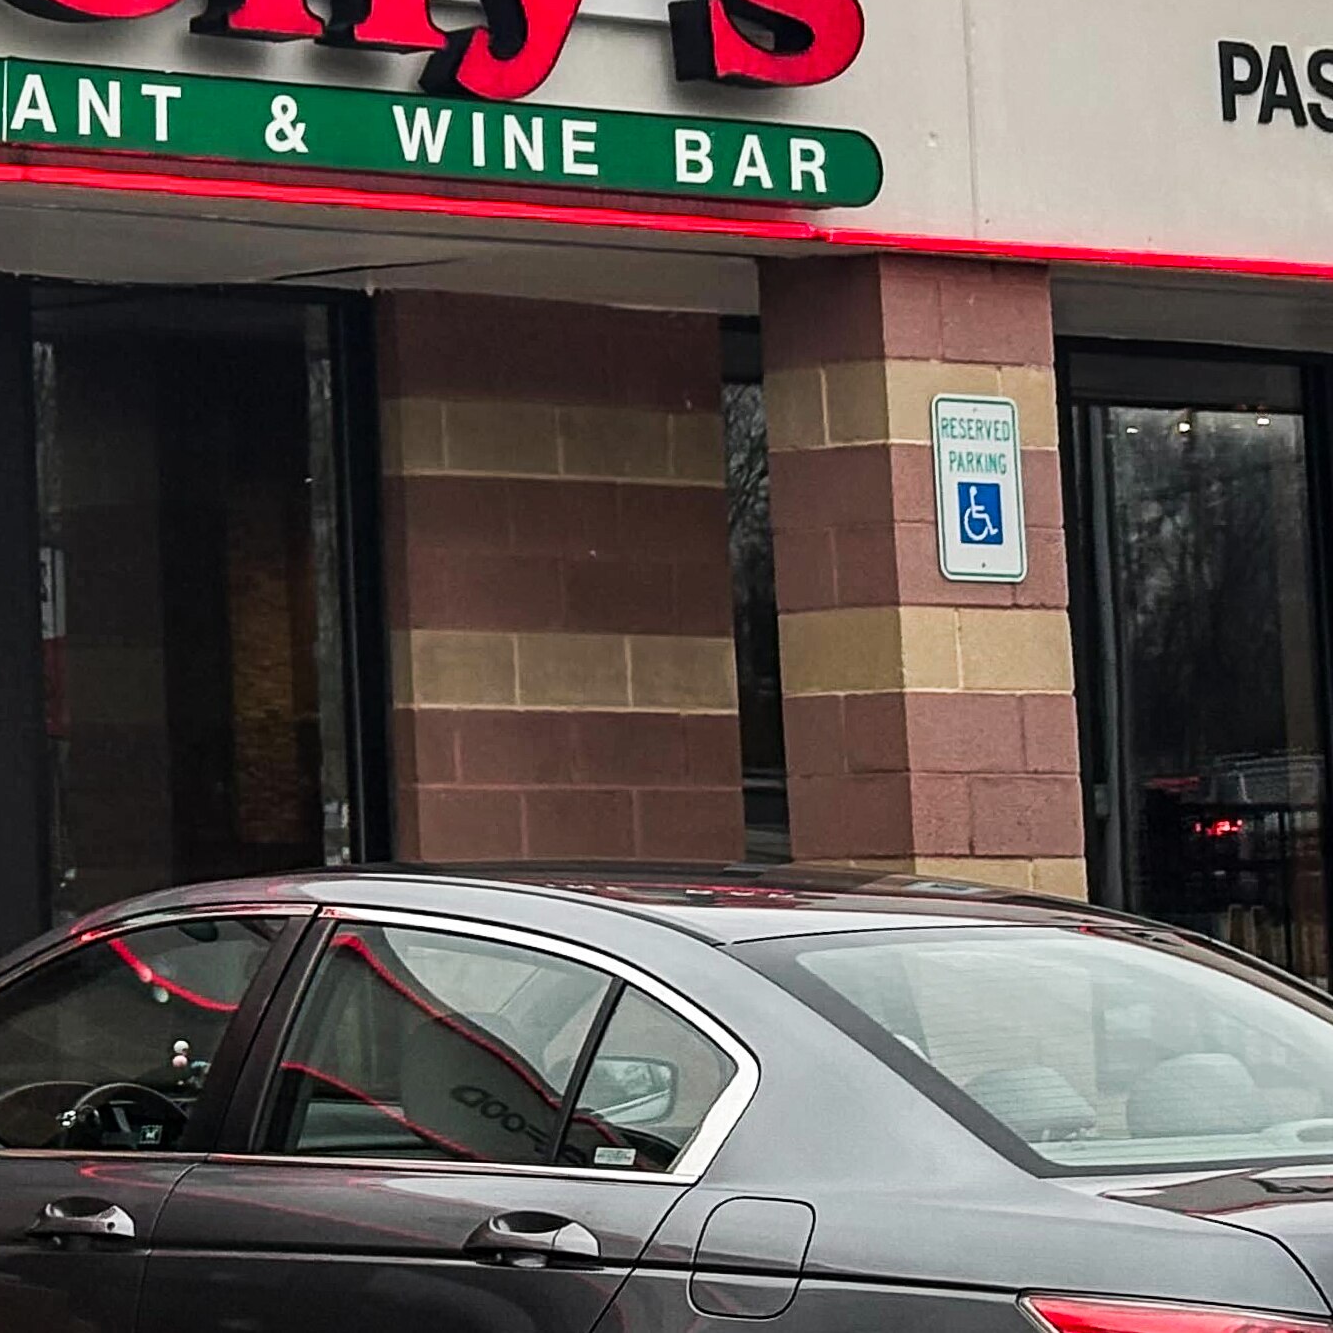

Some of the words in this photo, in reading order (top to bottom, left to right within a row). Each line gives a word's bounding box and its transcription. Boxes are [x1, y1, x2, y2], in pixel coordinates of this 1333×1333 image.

[264, 94, 309, 153] &
[392, 104, 599, 176] WINE
[674, 128, 827, 193] BAR
[940, 417, 1010, 442] RESERVED
[949, 450, 1007, 475] PARKING
